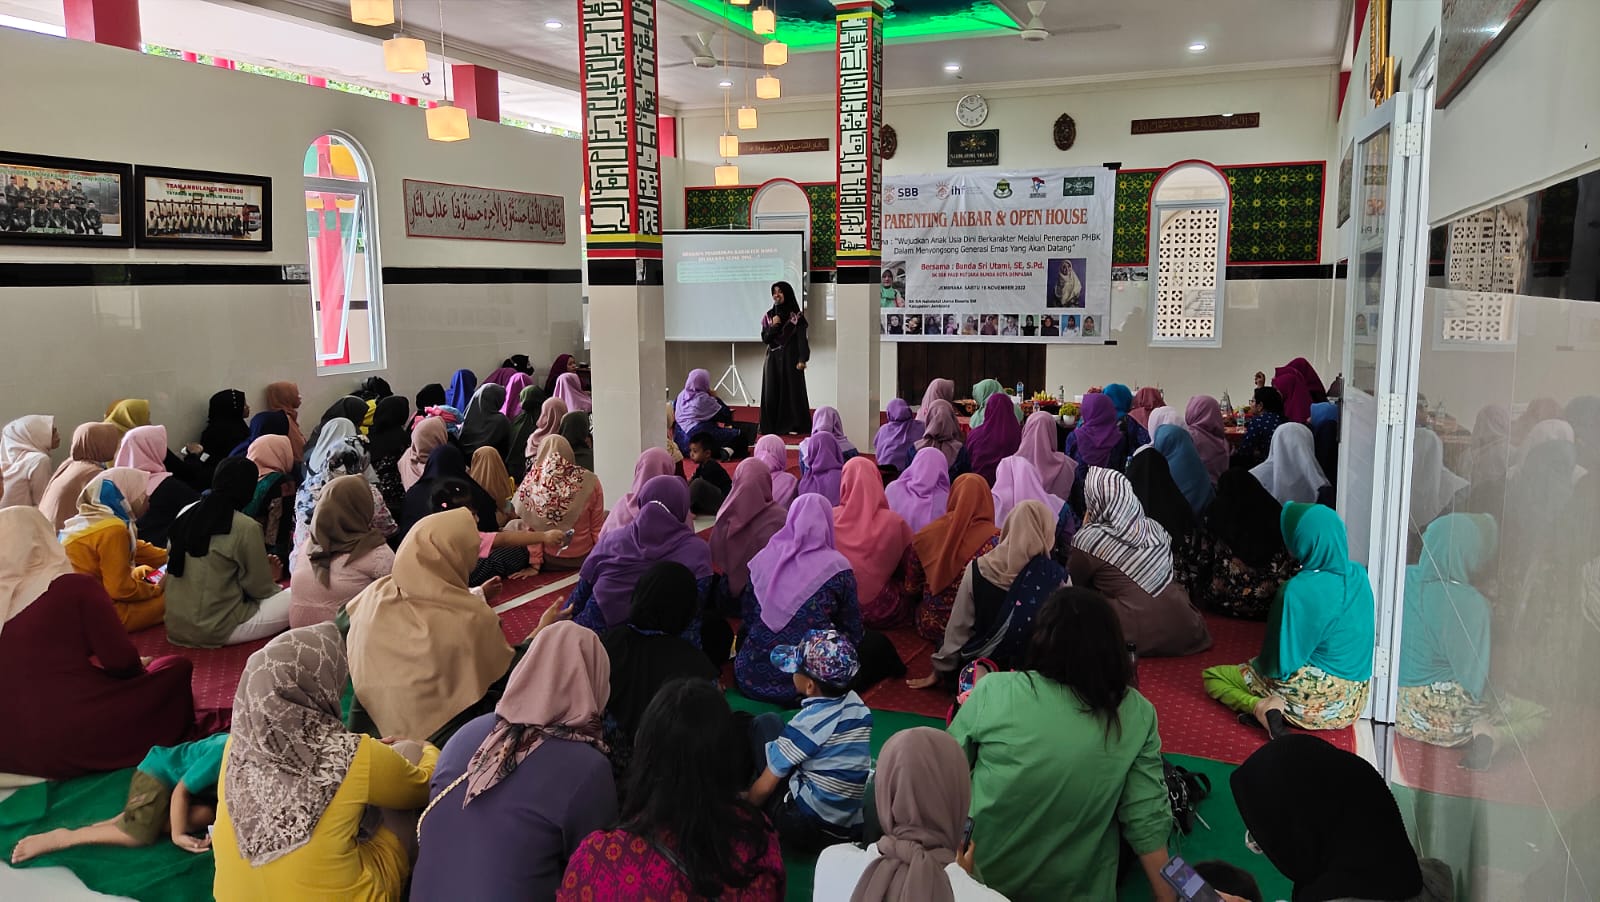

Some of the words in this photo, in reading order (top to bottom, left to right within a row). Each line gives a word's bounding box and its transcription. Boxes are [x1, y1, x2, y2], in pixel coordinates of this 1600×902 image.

[897, 187, 919, 198] SBB
[884, 212, 948, 229] PARENTING
[951, 210, 992, 227] AKBAR
[995, 209, 1007, 226] &
[1009, 208, 1042, 226] OPEN
[1045, 207, 1088, 225] HOUSE
[948, 236, 961, 244] Usia
[963, 235, 977, 243] Dini
[978, 234, 1016, 243] Berkarakter
[1018, 234, 1042, 242] Melalui
[1043, 233, 1079, 243] Penerapan
[1081, 233, 1101, 241] PHBK
[893, 247, 914, 255] Dalam
[916, 246, 959, 256] Menyongsong
[960, 245, 989, 253] Generasi
[990, 245, 1009, 253] Emas
[1010, 244, 1027, 255] Yang
[1028, 244, 1046, 252] Akan
[955, 262, 977, 270] Bunda
[977, 261, 988, 270] Sri
[989, 260, 1012, 270] Utami,
